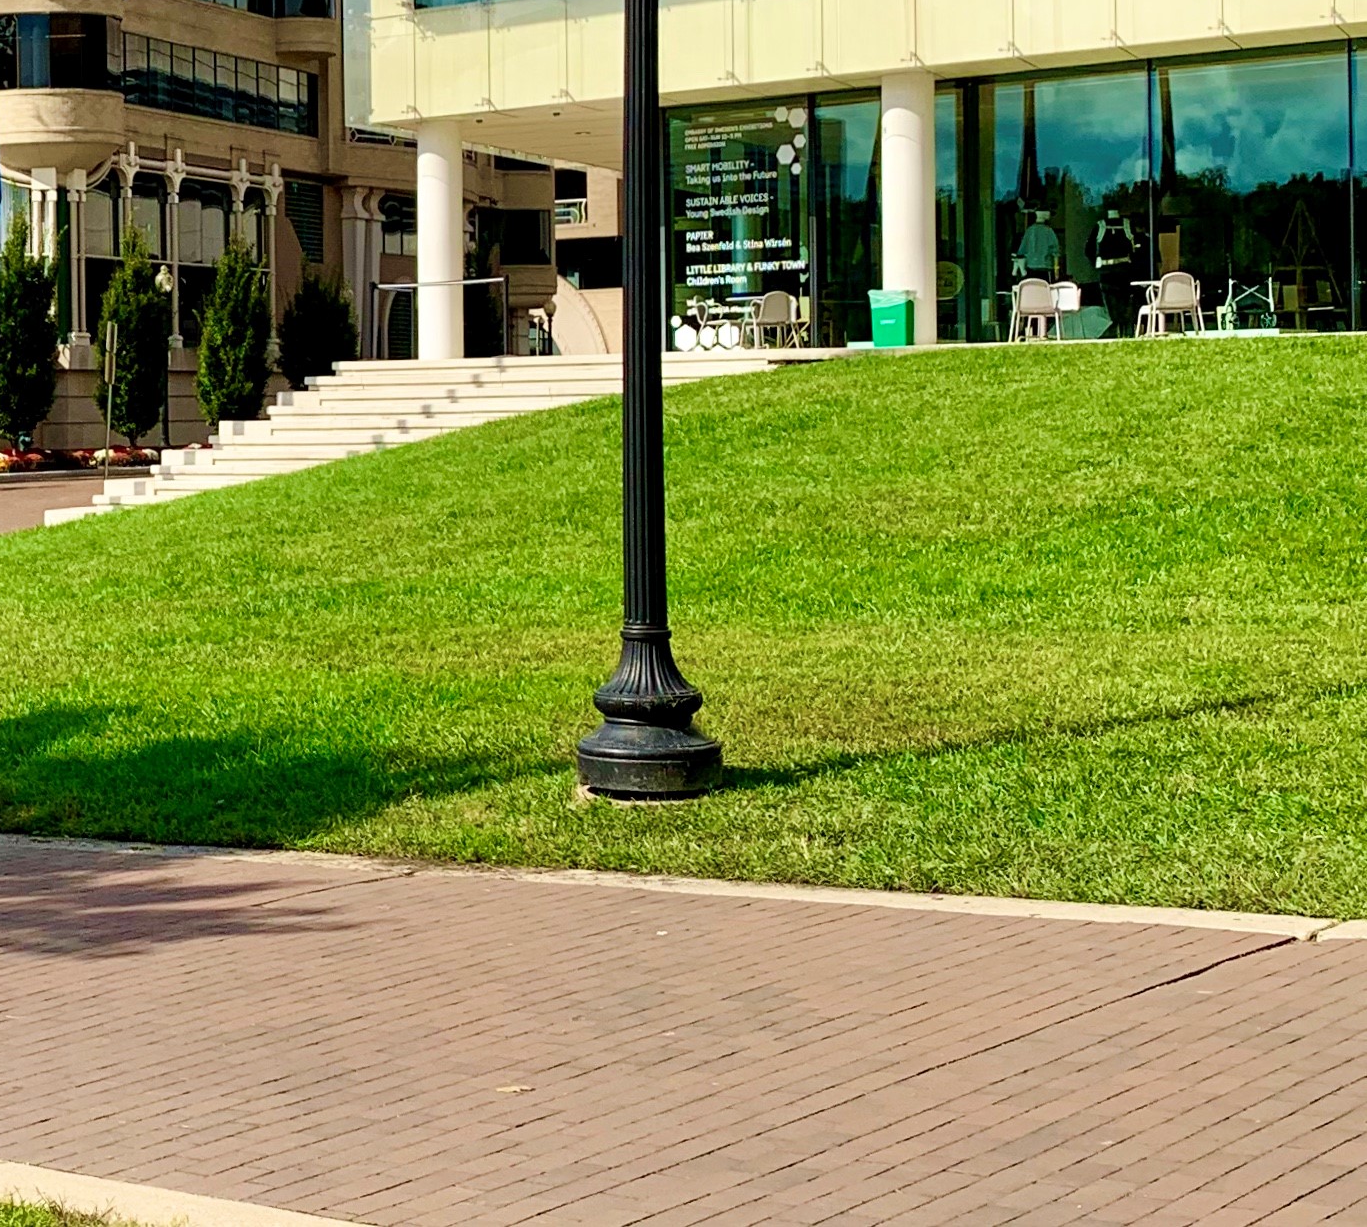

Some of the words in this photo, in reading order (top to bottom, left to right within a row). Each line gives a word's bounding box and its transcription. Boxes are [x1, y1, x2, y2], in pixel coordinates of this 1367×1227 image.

[686, 163, 710, 173] SMART
[712, 160, 749, 172] MOBILITY
[686, 175, 710, 185] Taking
[722, 173, 738, 182] into
[739, 172, 752, 181] the
[753, 171, 777, 180] Future
[740, 193, 769, 203] VOICES
[686, 210, 709, 219] Young
[710, 206, 742, 217] Swedish
[742, 205, 769, 216] Design
[686, 230, 714, 241] PAPIER
[736, 241, 742, 249] &
[743, 239, 764, 249] Stina
[686, 264, 713, 275] LITTLE
[713, 263, 746, 274] LIBRARY
[746, 262, 753, 271] &
[782, 260, 805, 269] TOWN
[687, 276, 724, 287] Children's
[726, 275, 747, 284] Room
